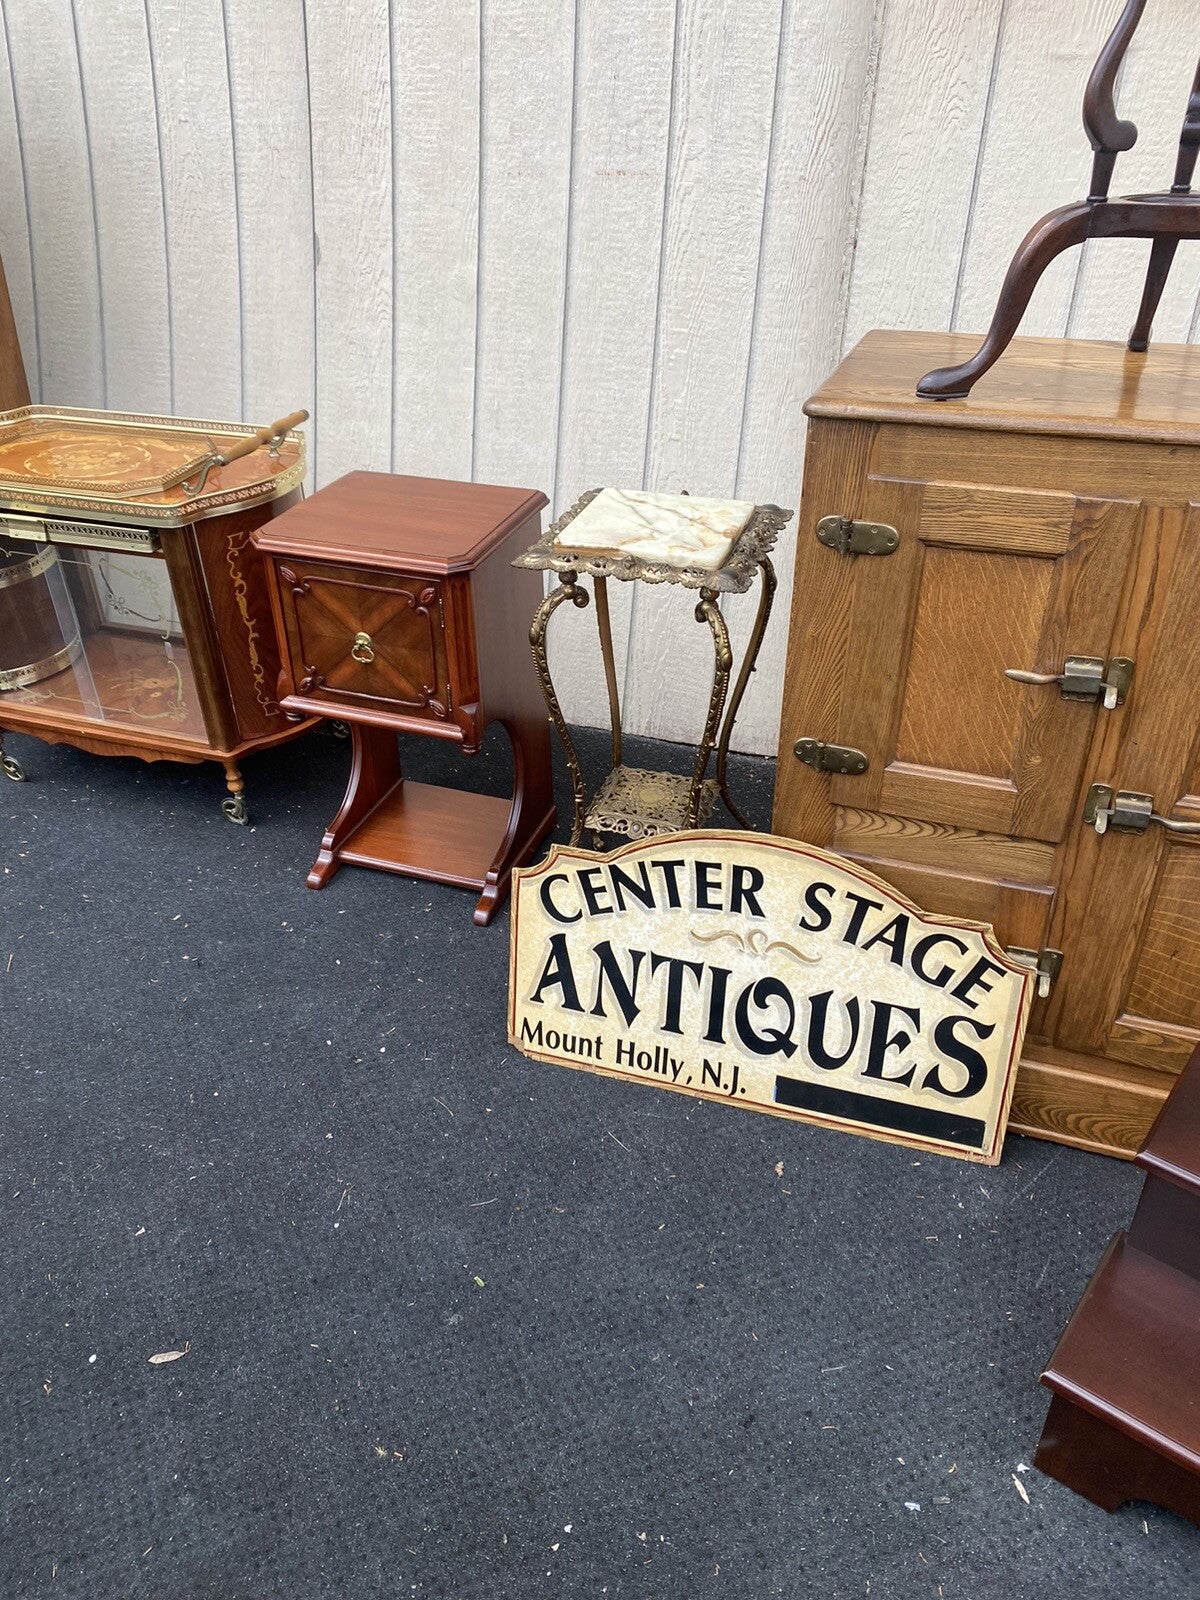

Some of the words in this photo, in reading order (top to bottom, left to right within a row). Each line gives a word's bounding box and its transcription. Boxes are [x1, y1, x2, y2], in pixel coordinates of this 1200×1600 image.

[540, 859, 766, 923] CENTER
[799, 882, 1006, 1009] STAGE
[520, 1017, 604, 1060] Mount
[615, 1039, 693, 1085] Holly,
[701, 1058, 747, 1096] N.J.
[530, 933, 996, 1099] ANTIQUES
